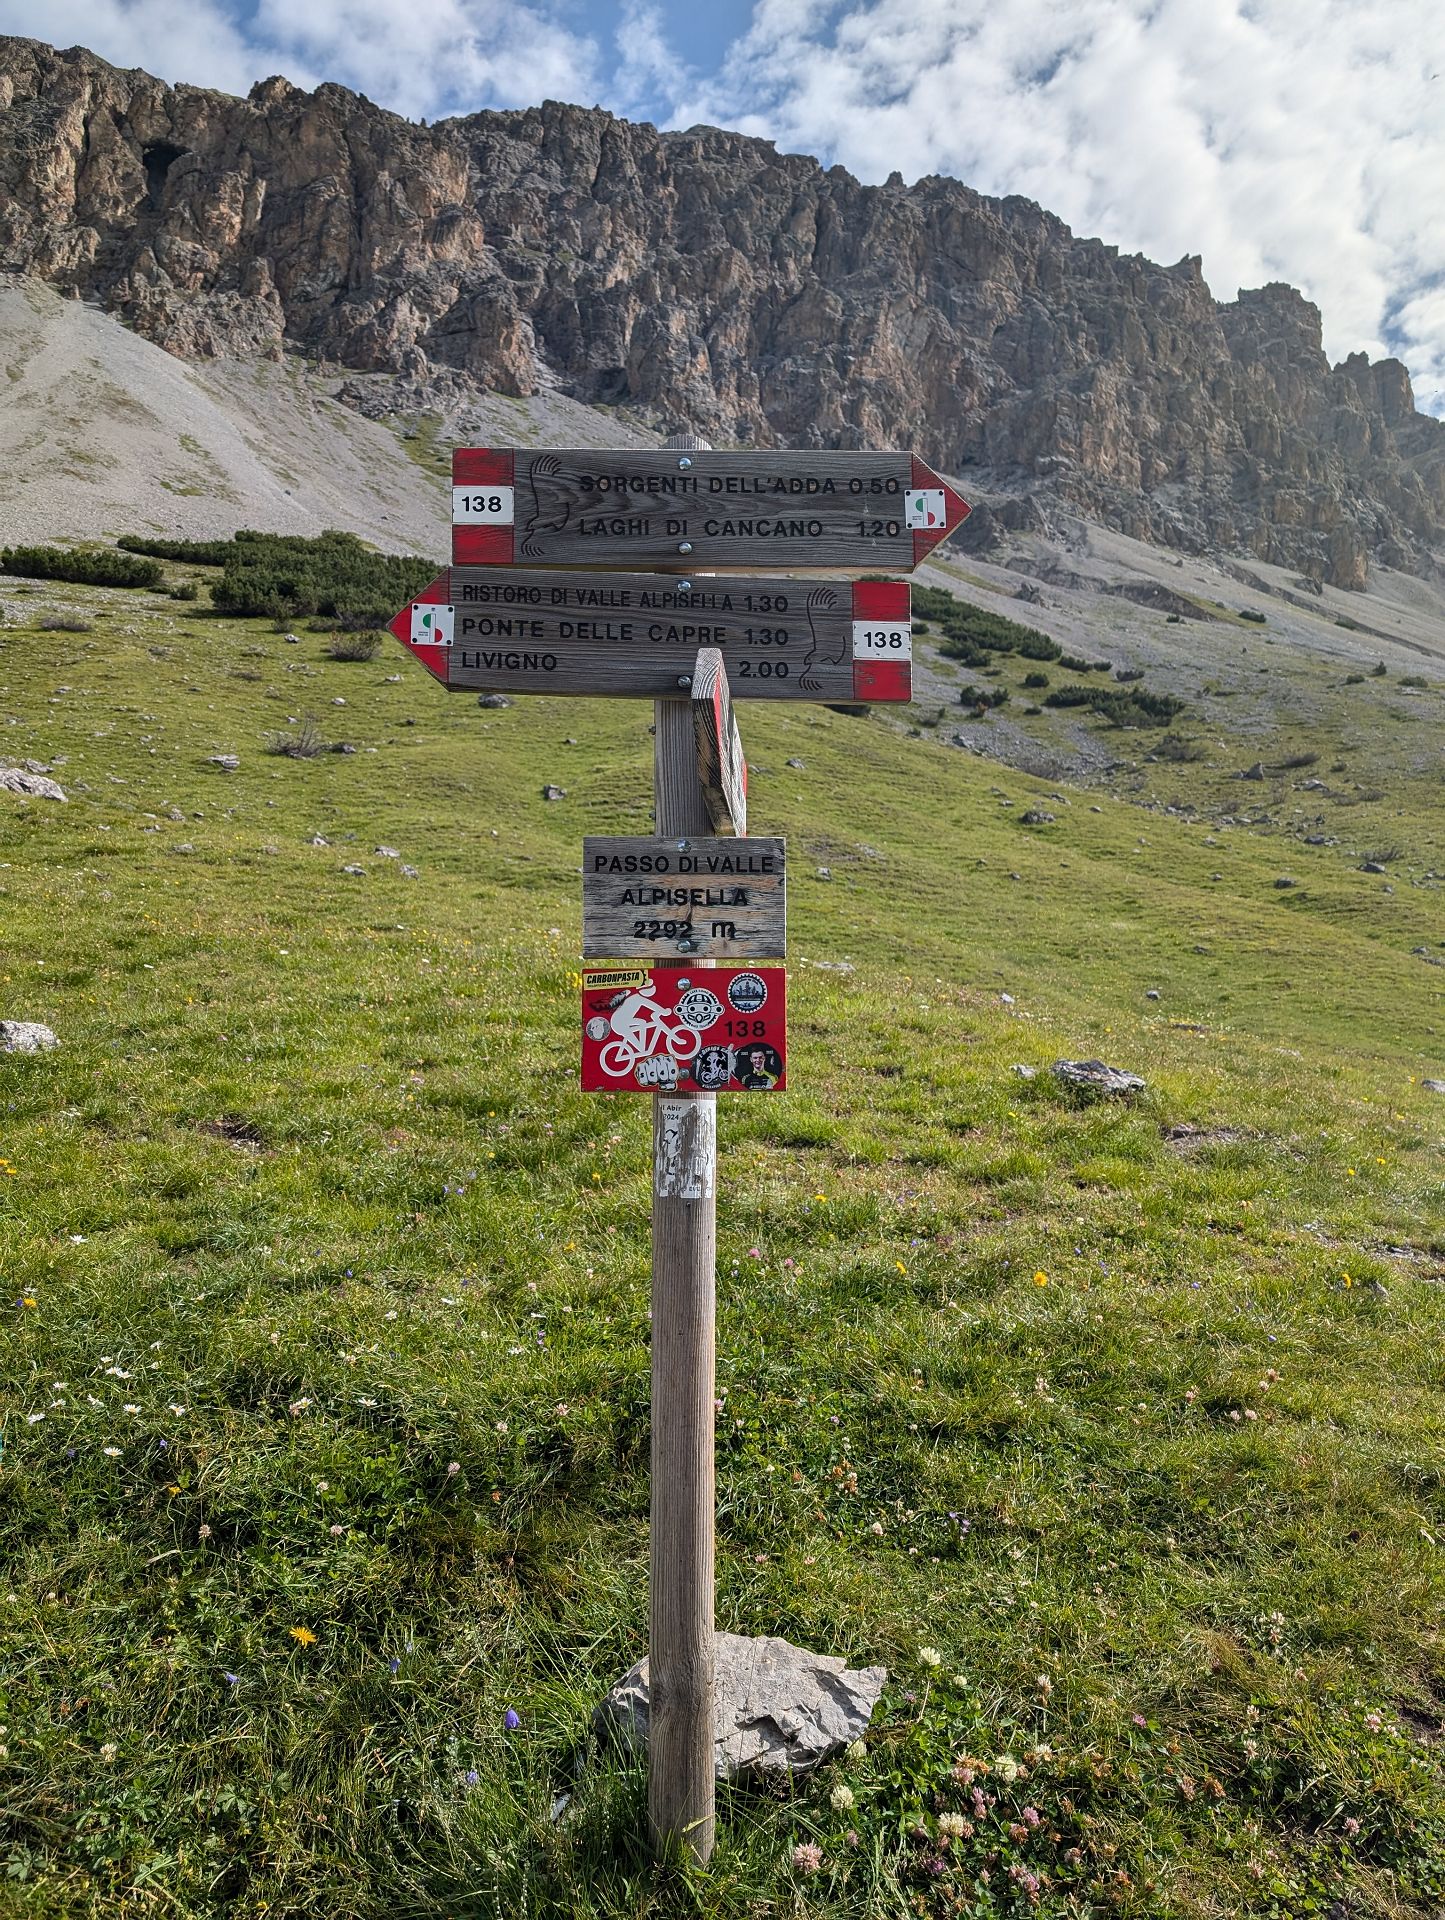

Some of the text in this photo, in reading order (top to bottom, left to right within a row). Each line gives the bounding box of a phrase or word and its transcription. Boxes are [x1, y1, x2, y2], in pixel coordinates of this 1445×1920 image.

[580, 475, 900, 495] SORGENTI DELL'ADDA 0.50
[461, 495, 502, 513] 138
[580, 518, 900, 537] LAGHI DI CANCANO 1.20
[462, 584, 789, 613] RISTORO DI VALLE ALPISELLA 1.30
[462, 618, 789, 646] PONTE DELLE CAPRE 1.30
[863, 631, 903, 649] 138
[462, 651, 789, 678] LIVIGNO 2.00
[594, 855, 774, 873] PASSO DI VALLE
[621, 888, 748, 906] ALPISELLA
[633, 920, 736, 939] 2292 m
[586, 971, 640, 984] CARBONPASTA
[724, 1020, 766, 1038] 138
